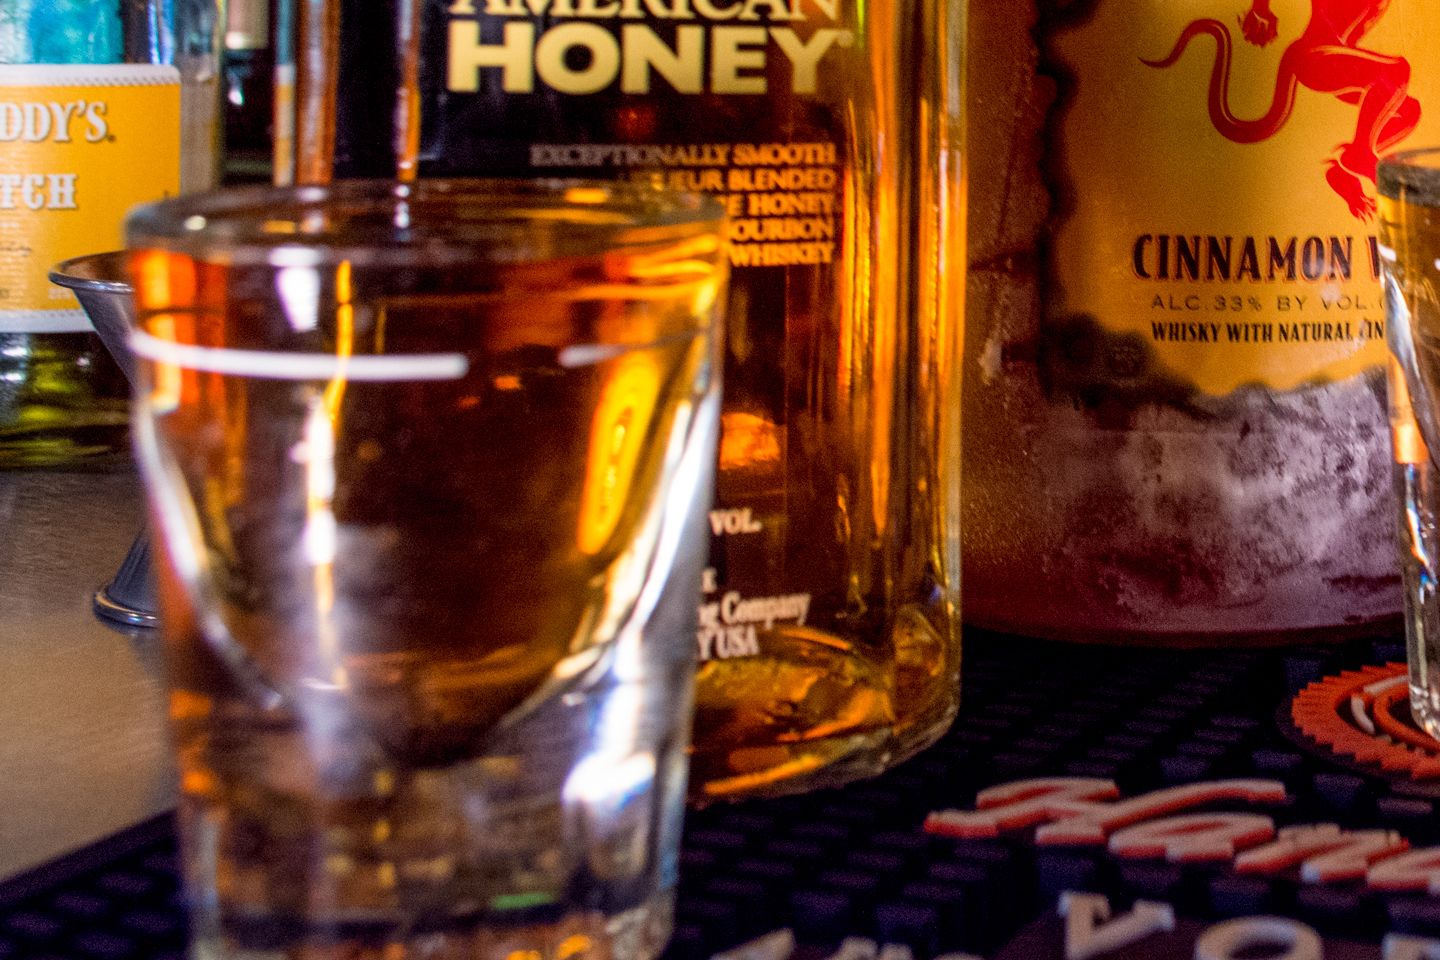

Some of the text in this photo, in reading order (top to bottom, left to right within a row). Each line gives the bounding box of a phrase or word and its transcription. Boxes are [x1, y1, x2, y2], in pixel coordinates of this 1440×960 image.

[446, 20, 842, 95] HONEY
[530, 143, 836, 167] EXCEPTIONALLY SMOOTH
[728, 169, 836, 191] BLENDED
[748, 192, 836, 216] HONEY
[729, 240, 835, 267] WHISKEY
[1132, 234, 1354, 283] CINNAMON
[1277, 295, 1308, 311] BY
[1152, 321, 1220, 343] WHISKY
[1226, 323, 1274, 343] WITH
[1278, 322, 1353, 342] NATURAL
[710, 508, 761, 535] VOL.
